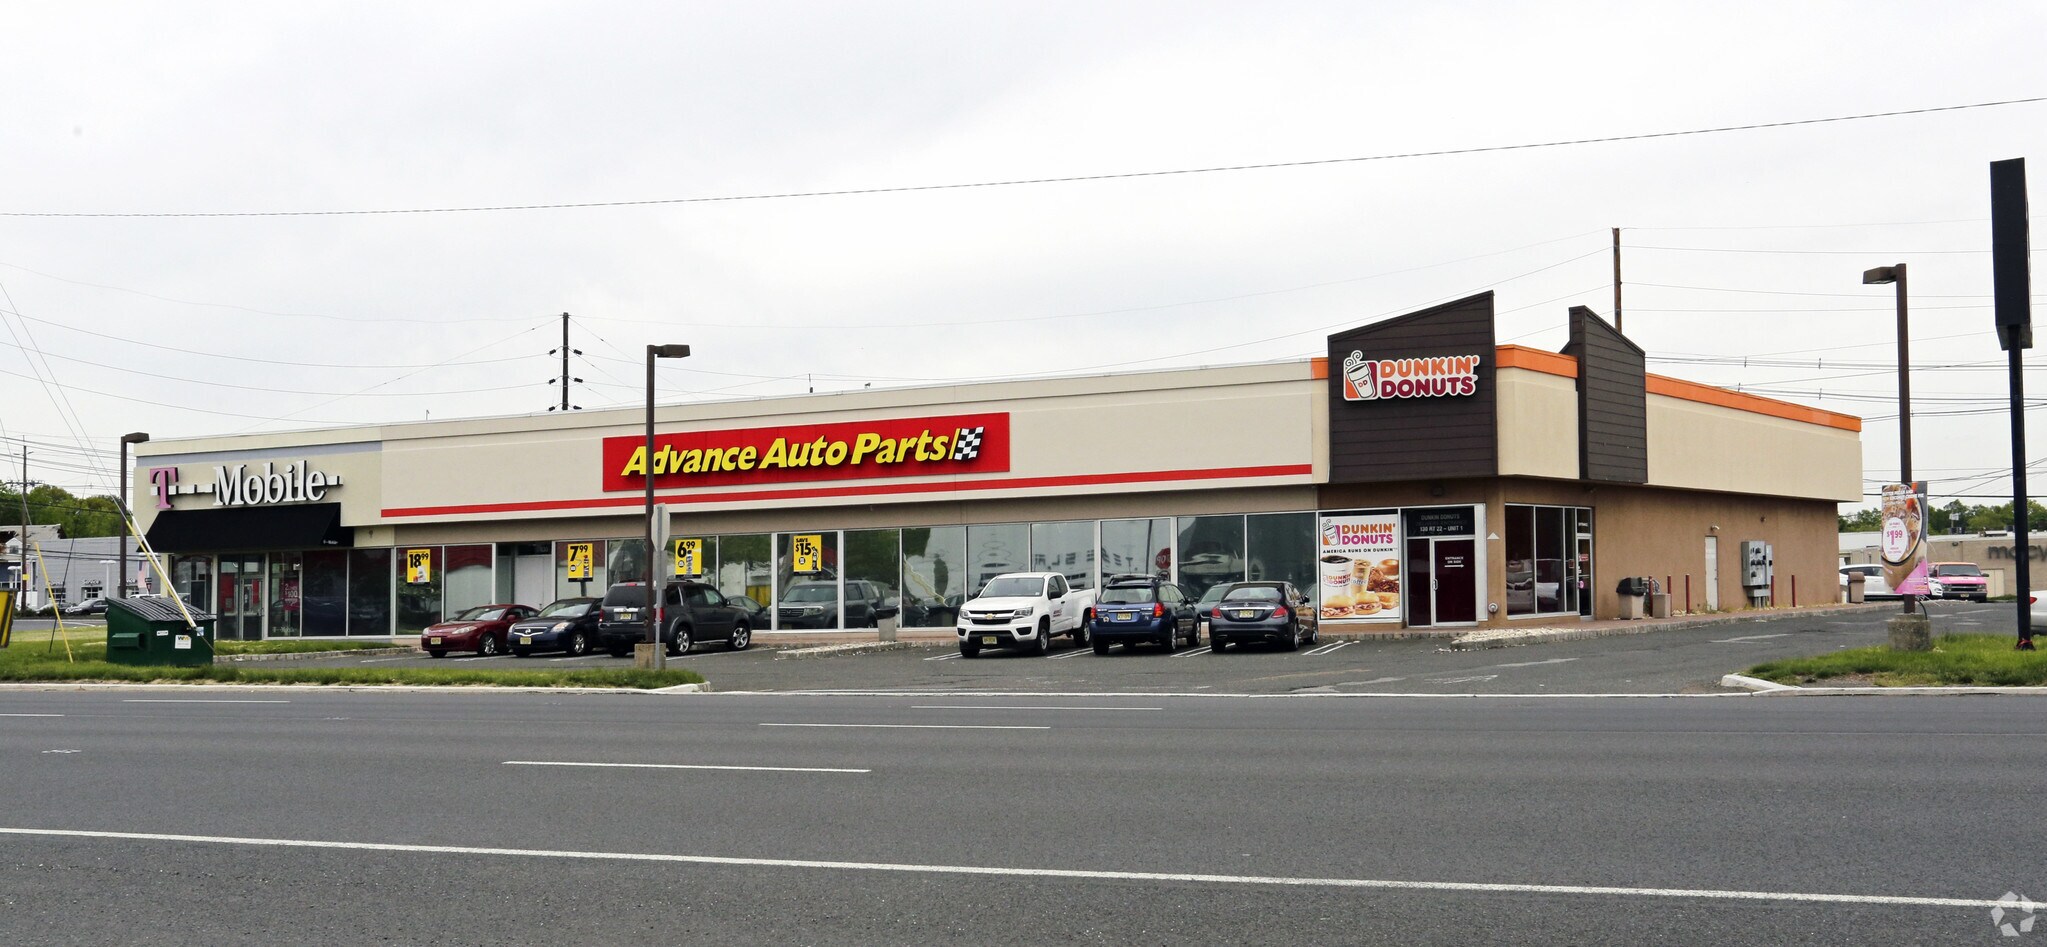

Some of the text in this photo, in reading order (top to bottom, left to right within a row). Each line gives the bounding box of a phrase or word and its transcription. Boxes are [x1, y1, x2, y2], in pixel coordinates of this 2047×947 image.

[1380, 356, 1478, 378] DUNKIN'
[1358, 380, 1368, 388] DD
[1380, 375, 1474, 398] DONUTS
[620, 429, 949, 476] Advance Auto Parts
[1341, 523, 1396, 535] DUNKIN'
[1341, 534, 1393, 545] DONUTS
[795, 543, 811, 556] $15
